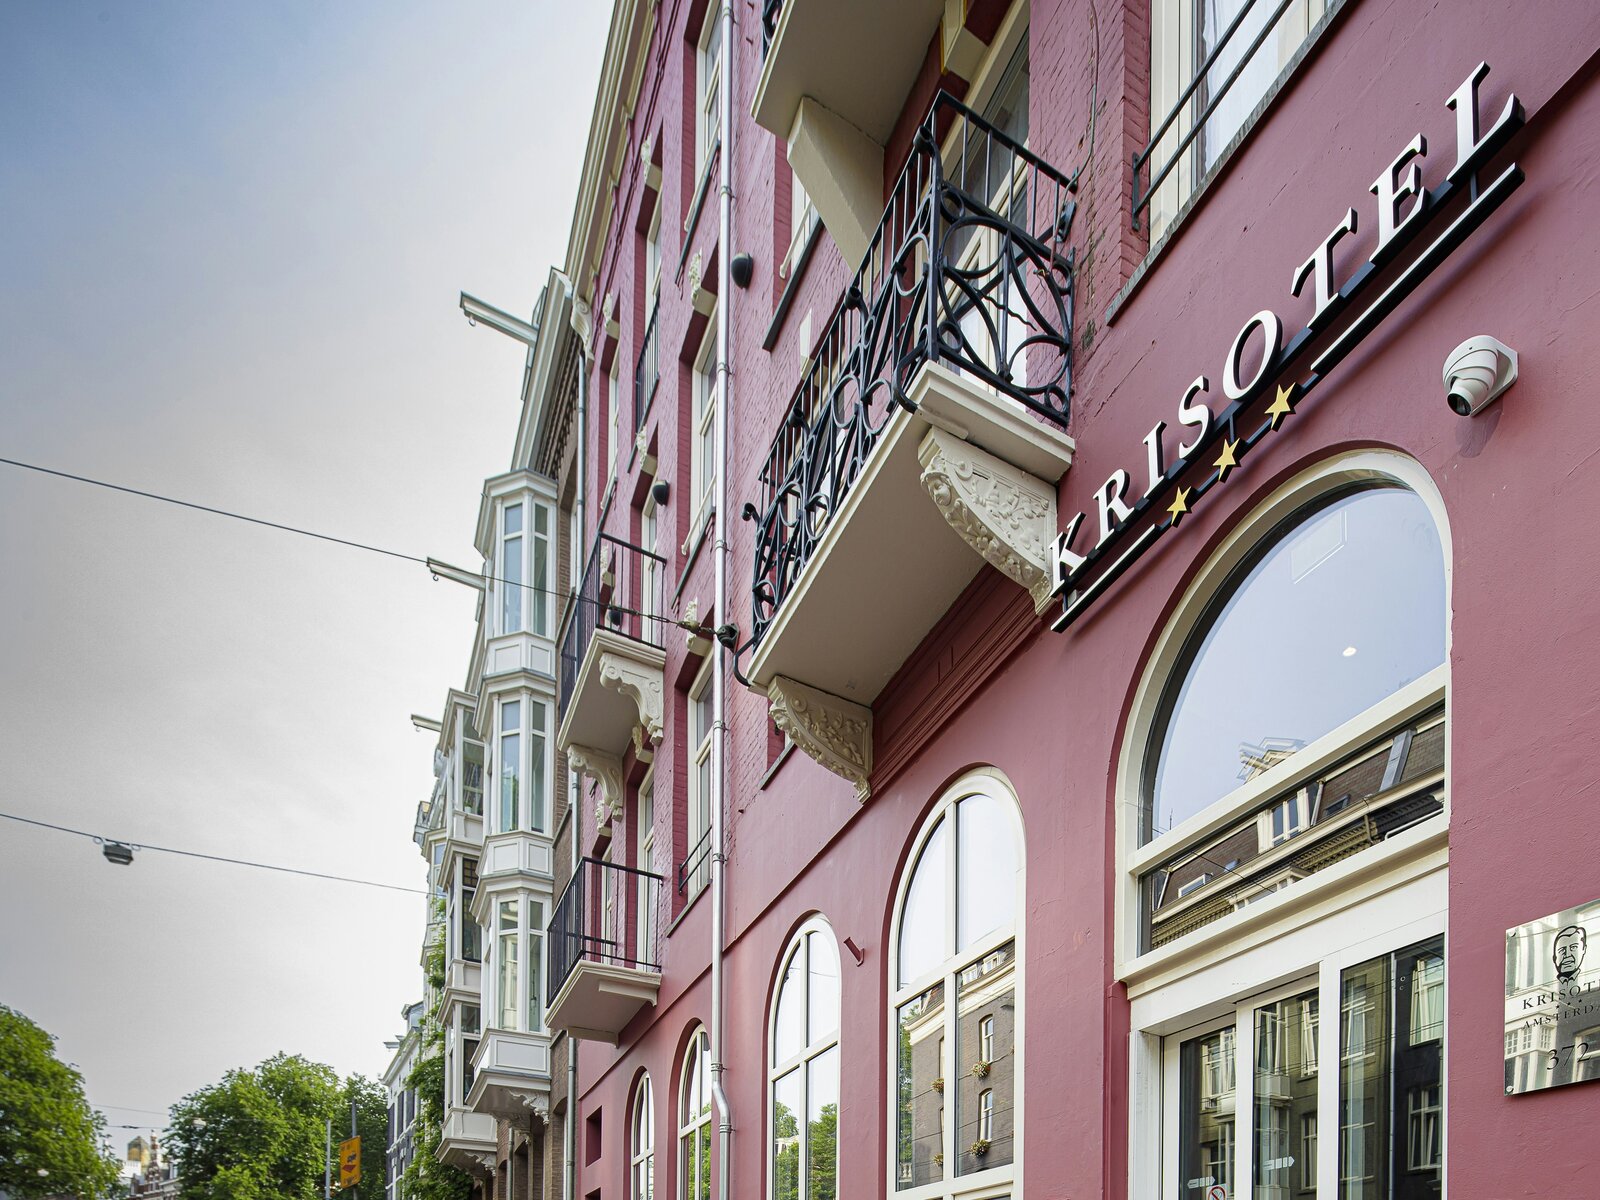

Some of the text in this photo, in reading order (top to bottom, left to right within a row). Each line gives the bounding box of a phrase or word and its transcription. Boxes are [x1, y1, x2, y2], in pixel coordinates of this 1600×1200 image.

[1049, 60, 1522, 598] KRISOTEL
[1523, 979, 1600, 1010] KRISOT
[1546, 1042, 1592, 1070] 372
